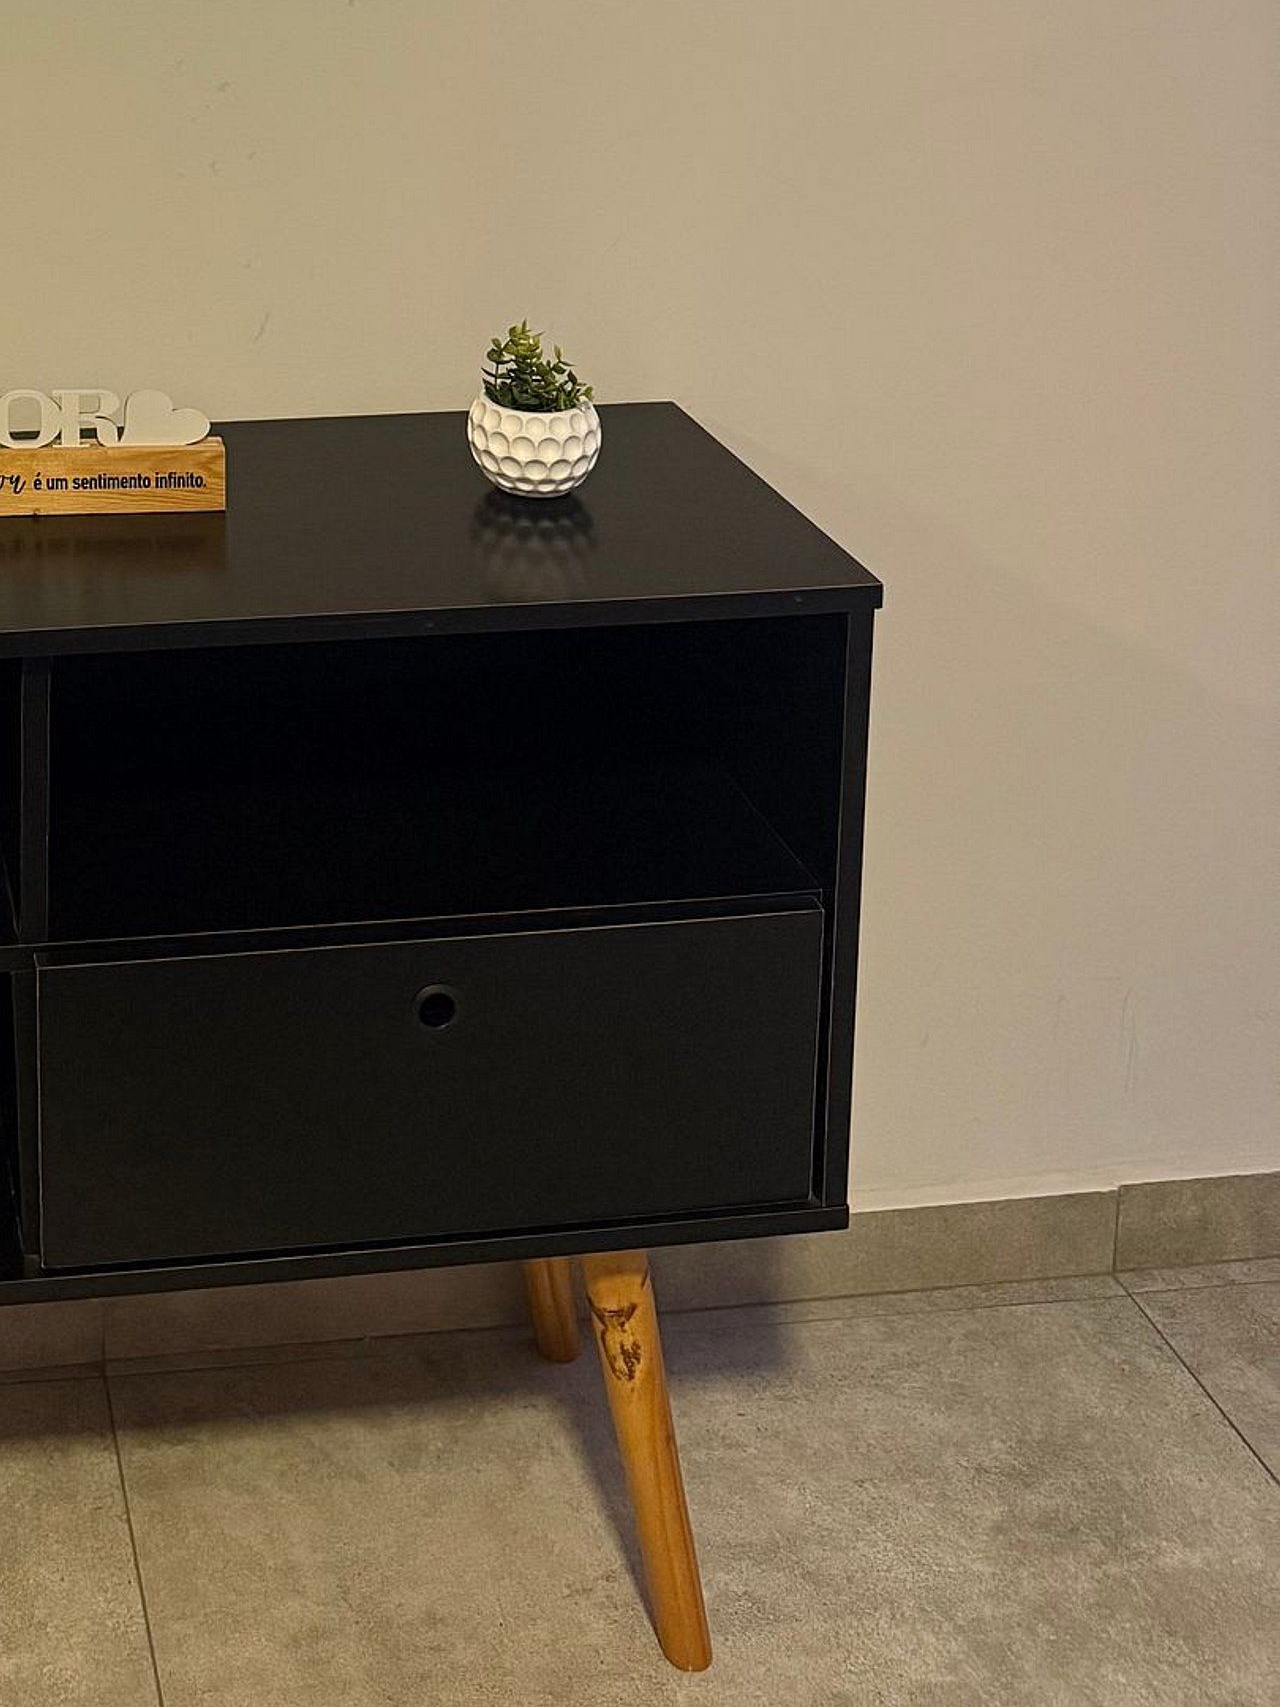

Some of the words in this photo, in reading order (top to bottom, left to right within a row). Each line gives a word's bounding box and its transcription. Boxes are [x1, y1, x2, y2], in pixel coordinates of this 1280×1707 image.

[33, 471, 42, 491] é
[45, 476, 68, 491] um
[72, 472, 151, 491] sentimento
[154, 471, 208, 490] infinito.
